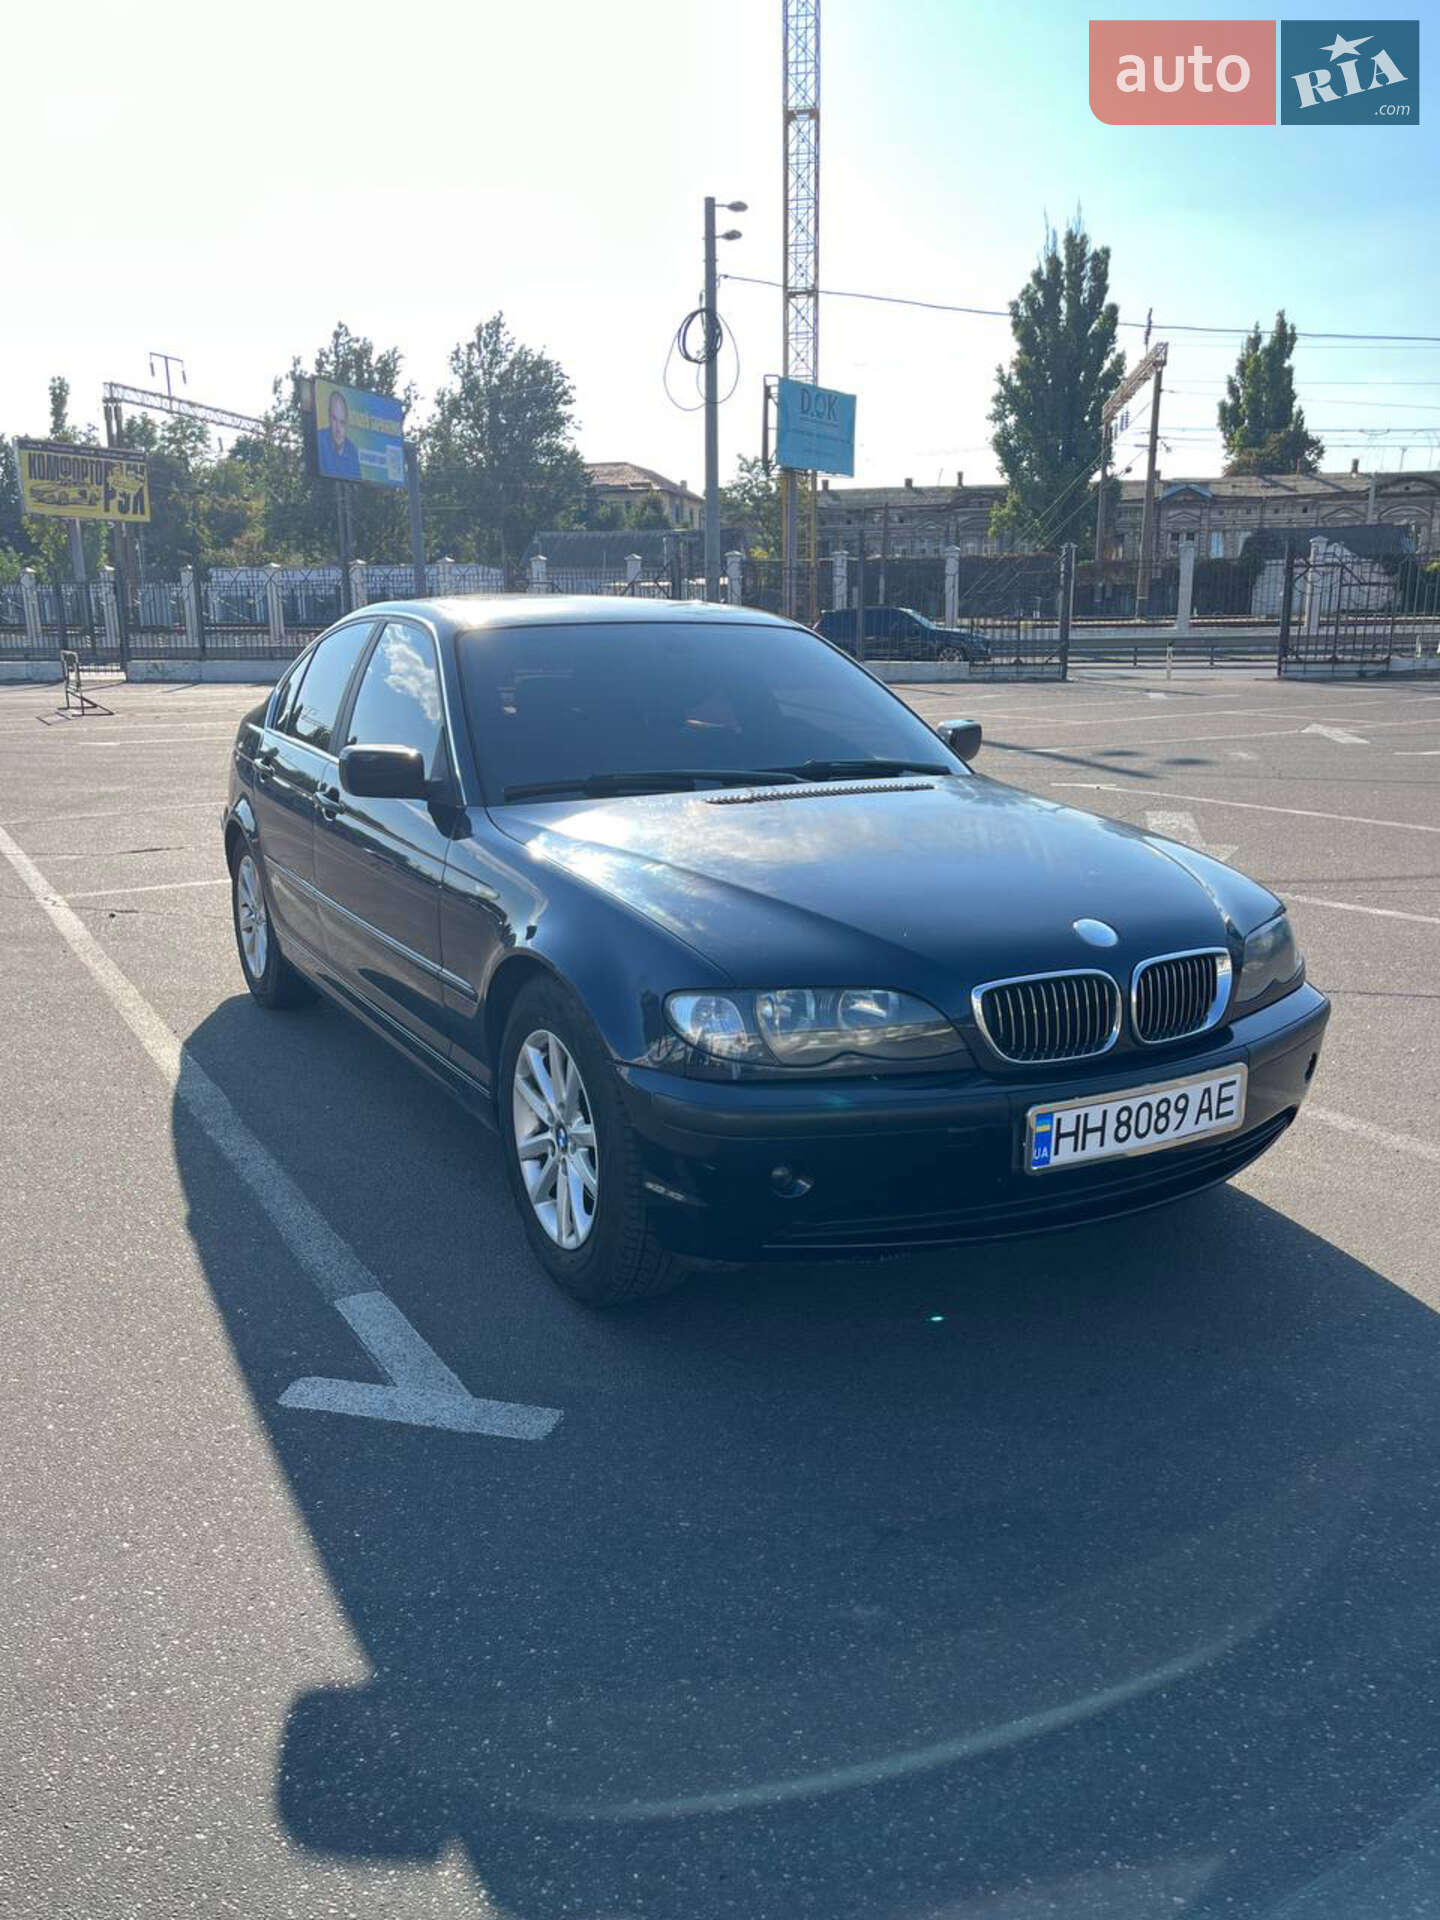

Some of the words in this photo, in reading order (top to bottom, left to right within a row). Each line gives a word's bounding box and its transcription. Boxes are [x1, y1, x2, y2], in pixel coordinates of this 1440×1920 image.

[1054, 1109, 1108, 1156] HH
[1114, 1092, 1190, 1143] 8089
[1194, 1079, 1237, 1126] AE
[1033, 1148, 1049, 1161] UA
